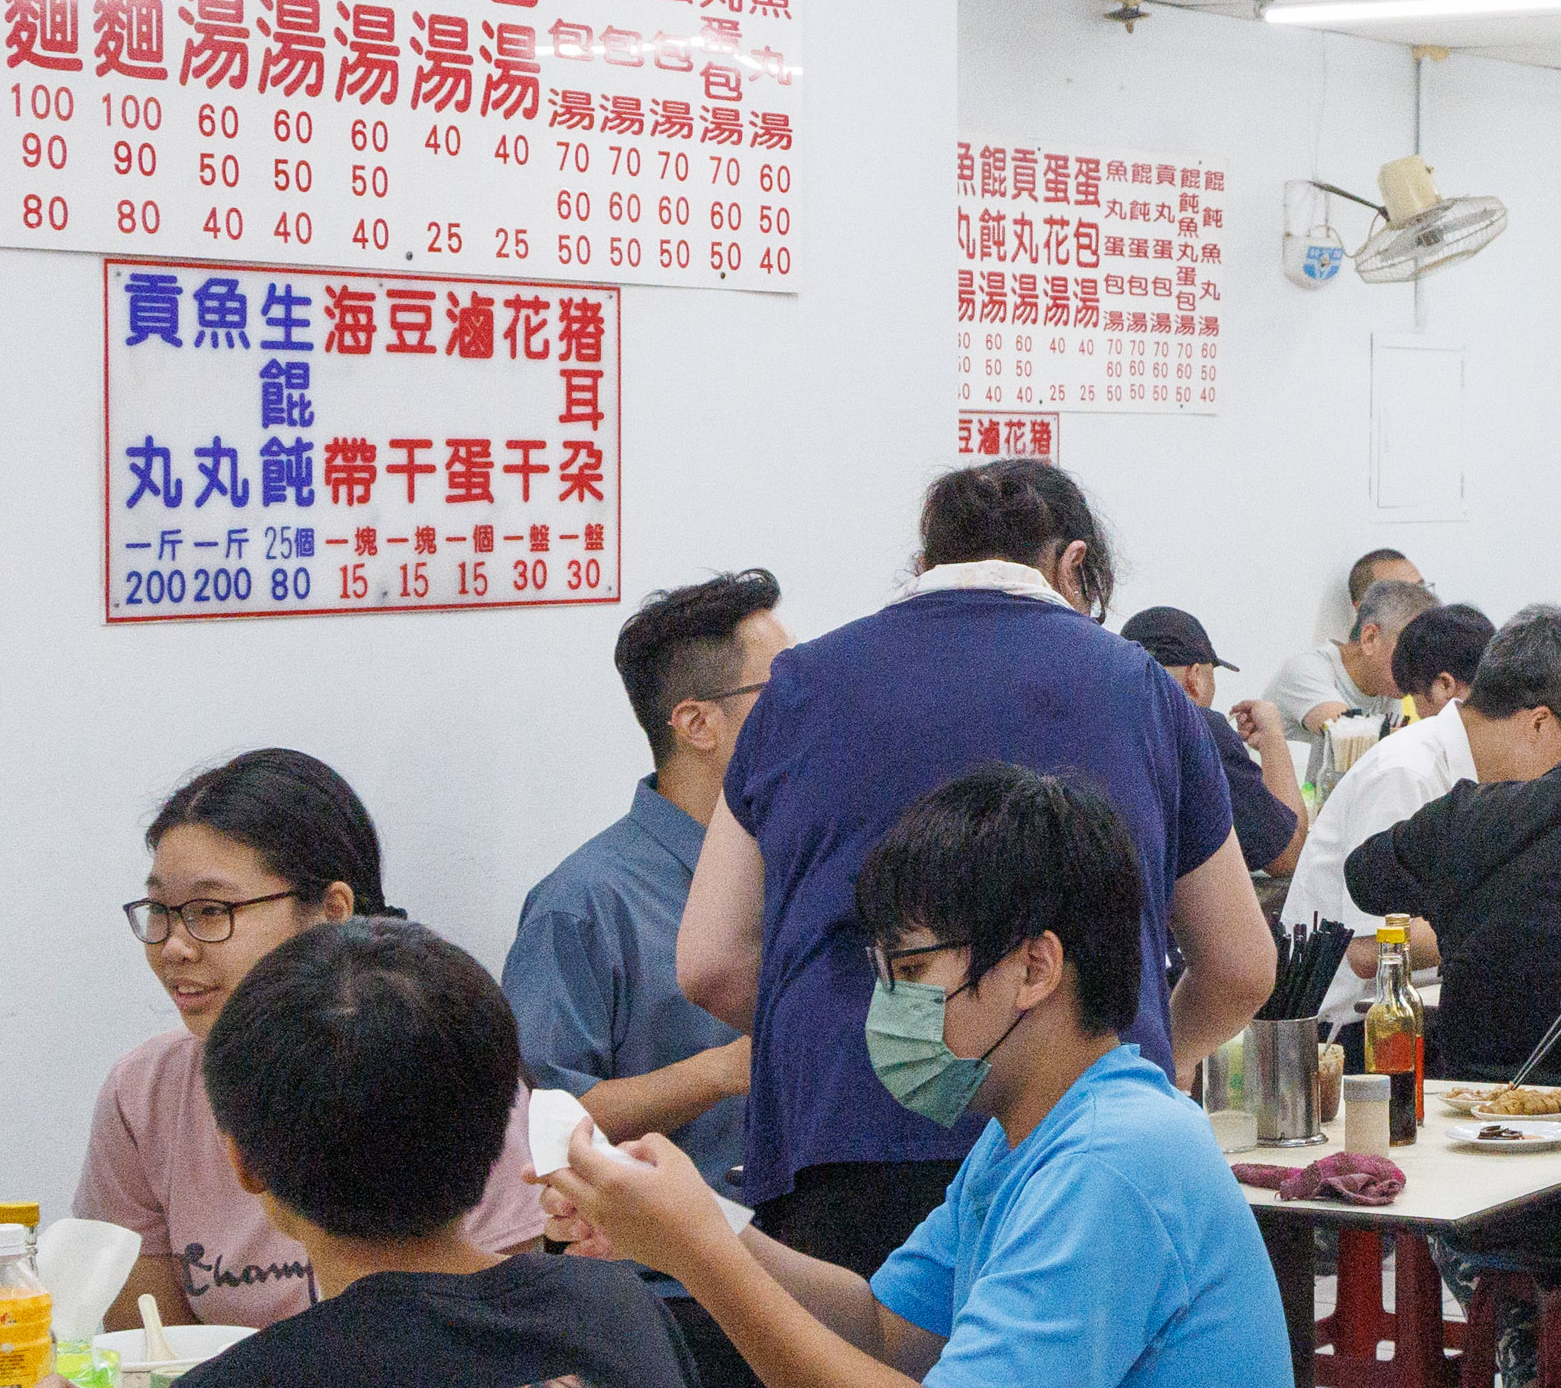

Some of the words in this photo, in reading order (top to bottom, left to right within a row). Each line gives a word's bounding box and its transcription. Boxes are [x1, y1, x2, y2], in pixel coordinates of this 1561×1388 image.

[11, 83, 74, 122] 100
[102, 94, 162, 131] 100
[198, 103, 239, 139] 60
[273, 109, 313, 144] 60
[351, 119, 389, 153] 60
[424, 125, 461, 157] 40
[494, 134, 529, 166] 40
[557, 141, 590, 173] 70
[609, 146, 641, 177] 70
[658, 151, 689, 182] 70
[710, 156, 740, 186] 70
[759, 164, 791, 194] 60
[22, 132, 67, 170] 90
[114, 140, 157, 177] 90
[199, 152, 239, 188] 50
[274, 158, 312, 193] 50
[352, 164, 388, 198] 50
[557, 190, 591, 222] 60
[609, 191, 641, 223] 60
[658, 196, 690, 226] 60
[710, 201, 742, 231] 60
[759, 205, 790, 236] 50
[23, 193, 68, 231] 80
[117, 199, 160, 234] 80
[202, 207, 243, 241] 40
[273, 212, 312, 245] 40
[352, 218, 389, 250] 40
[427, 221, 463, 254] 25
[495, 228, 529, 259] 25
[558, 234, 591, 266] 50
[610, 237, 641, 267] 50
[660, 239, 690, 269] 50
[711, 241, 742, 271] 50
[759, 247, 791, 275] 40
[979, 146, 1007, 323] 餛飩湯
[1011, 149, 1039, 325] 貢丸湯
[1043, 154, 1070, 326] 蛋花湯
[1073, 157, 1101, 328] 蛋包湯
[1104, 161, 1126, 331] 魚丸蛋包湯
[1128, 164, 1151, 332] 餛飩蛋包湯
[1151, 165, 1175, 332] 貢丸蛋包湯
[1176, 169, 1199, 334] 餛飩魚丸蛋包湯
[1200, 171, 1224, 335] 餛飩魚丸湯
[124, 273, 183, 509] 貢丸
[192, 277, 251, 509] 魚丸
[258, 282, 315, 508] 生餛飩
[323, 284, 378, 507] 海帶
[385, 288, 437, 504] 豆干
[445, 291, 496, 505] 滷蛋
[502, 293, 551, 503] 花干
[985, 332, 1003, 350] 60
[1015, 334, 1033, 353] 60
[1048, 337, 1066, 354] 40
[1078, 339, 1094, 355] 40
[1107, 339, 1122, 356] 70
[1130, 340, 1145, 356] 70
[1153, 341, 1169, 358] 70
[1177, 342, 1193, 359] 70
[1201, 342, 1217, 359] 60
[985, 357, 1003, 376] 50
[1015, 359, 1033, 377] 50
[1107, 361, 1122, 377] 60
[1130, 360, 1145, 376] 60
[1153, 362, 1168, 379] 60
[1177, 364, 1192, 379] 60
[1201, 365, 1216, 380] 50
[985, 386, 1002, 402] 40
[1016, 387, 1033, 403] 40
[1049, 385, 1065, 401] 25
[1079, 385, 1095, 401] 25
[1107, 385, 1121, 402] 50
[1130, 384, 1145, 400] 50
[1153, 385, 1168, 402] 50
[1176, 387, 1191, 403] 50
[1200, 386, 1215, 402] 40
[125, 569, 186, 605] 200
[194, 566, 251, 603] 200
[270, 567, 311, 601] 80
[339, 563, 369, 600] 15
[400, 561, 429, 599] 15
[458, 561, 488, 597] 15
[513, 559, 548, 591] 30
[567, 558, 601, 591] 30
[126, 529, 183, 561] 一斤
[194, 527, 249, 559] 一斤
[265, 525, 315, 560] 25個
[325, 526, 378, 557] 一塊
[386, 525, 437, 555] 一塊
[445, 525, 495, 553] 一個
